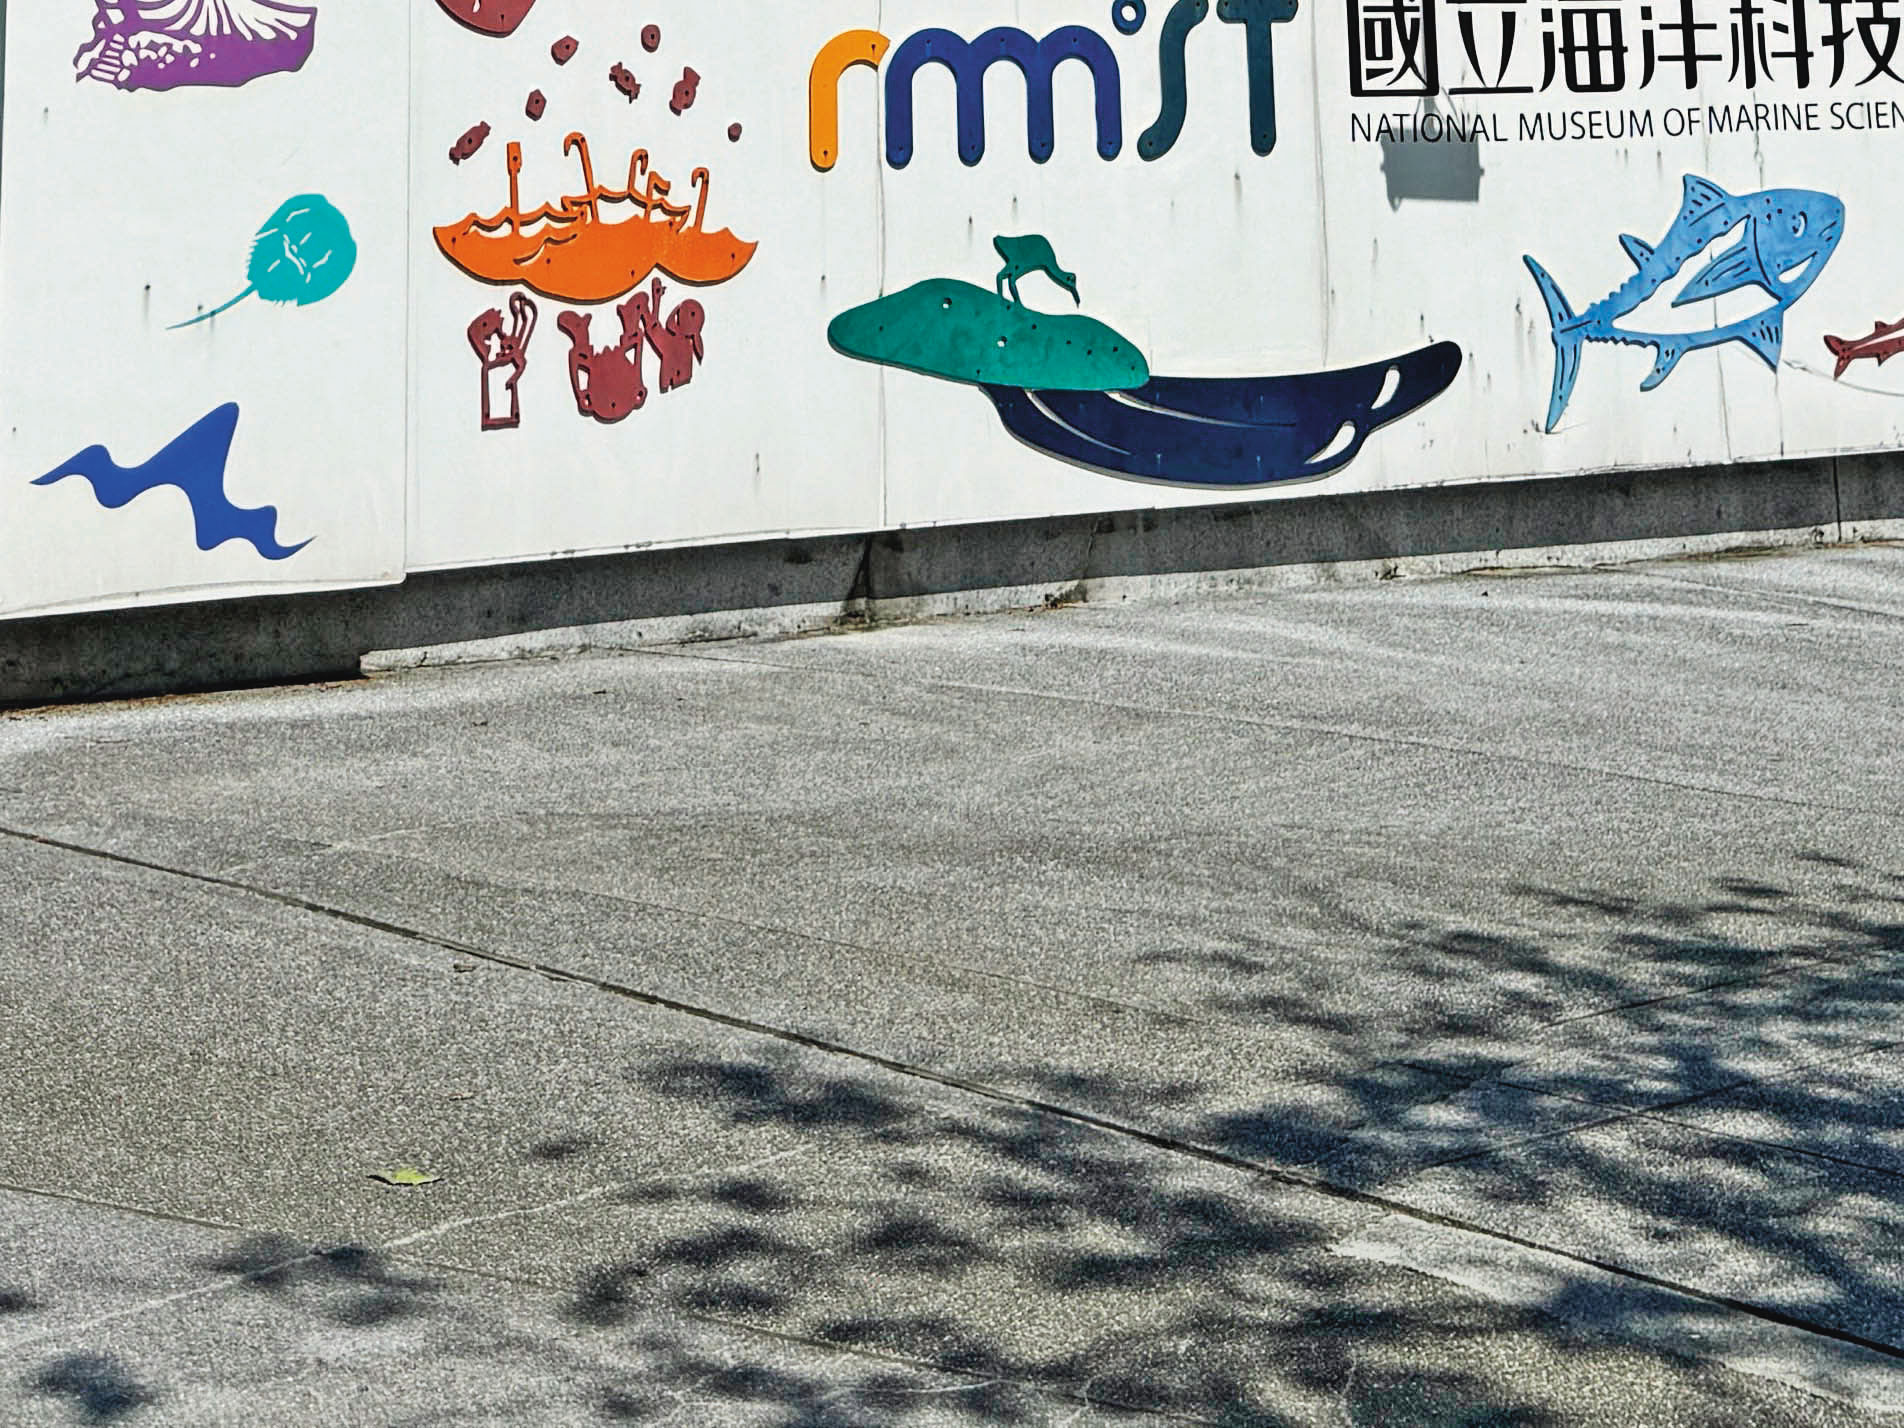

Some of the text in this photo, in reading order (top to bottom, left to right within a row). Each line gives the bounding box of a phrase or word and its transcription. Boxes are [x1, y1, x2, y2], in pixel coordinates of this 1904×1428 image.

[1351, 111, 1508, 142] NATIONAL
[1519, 108, 1654, 141] MUSEUM
[1663, 107, 1700, 137] OF
[1708, 102, 1820, 135] MARINE
